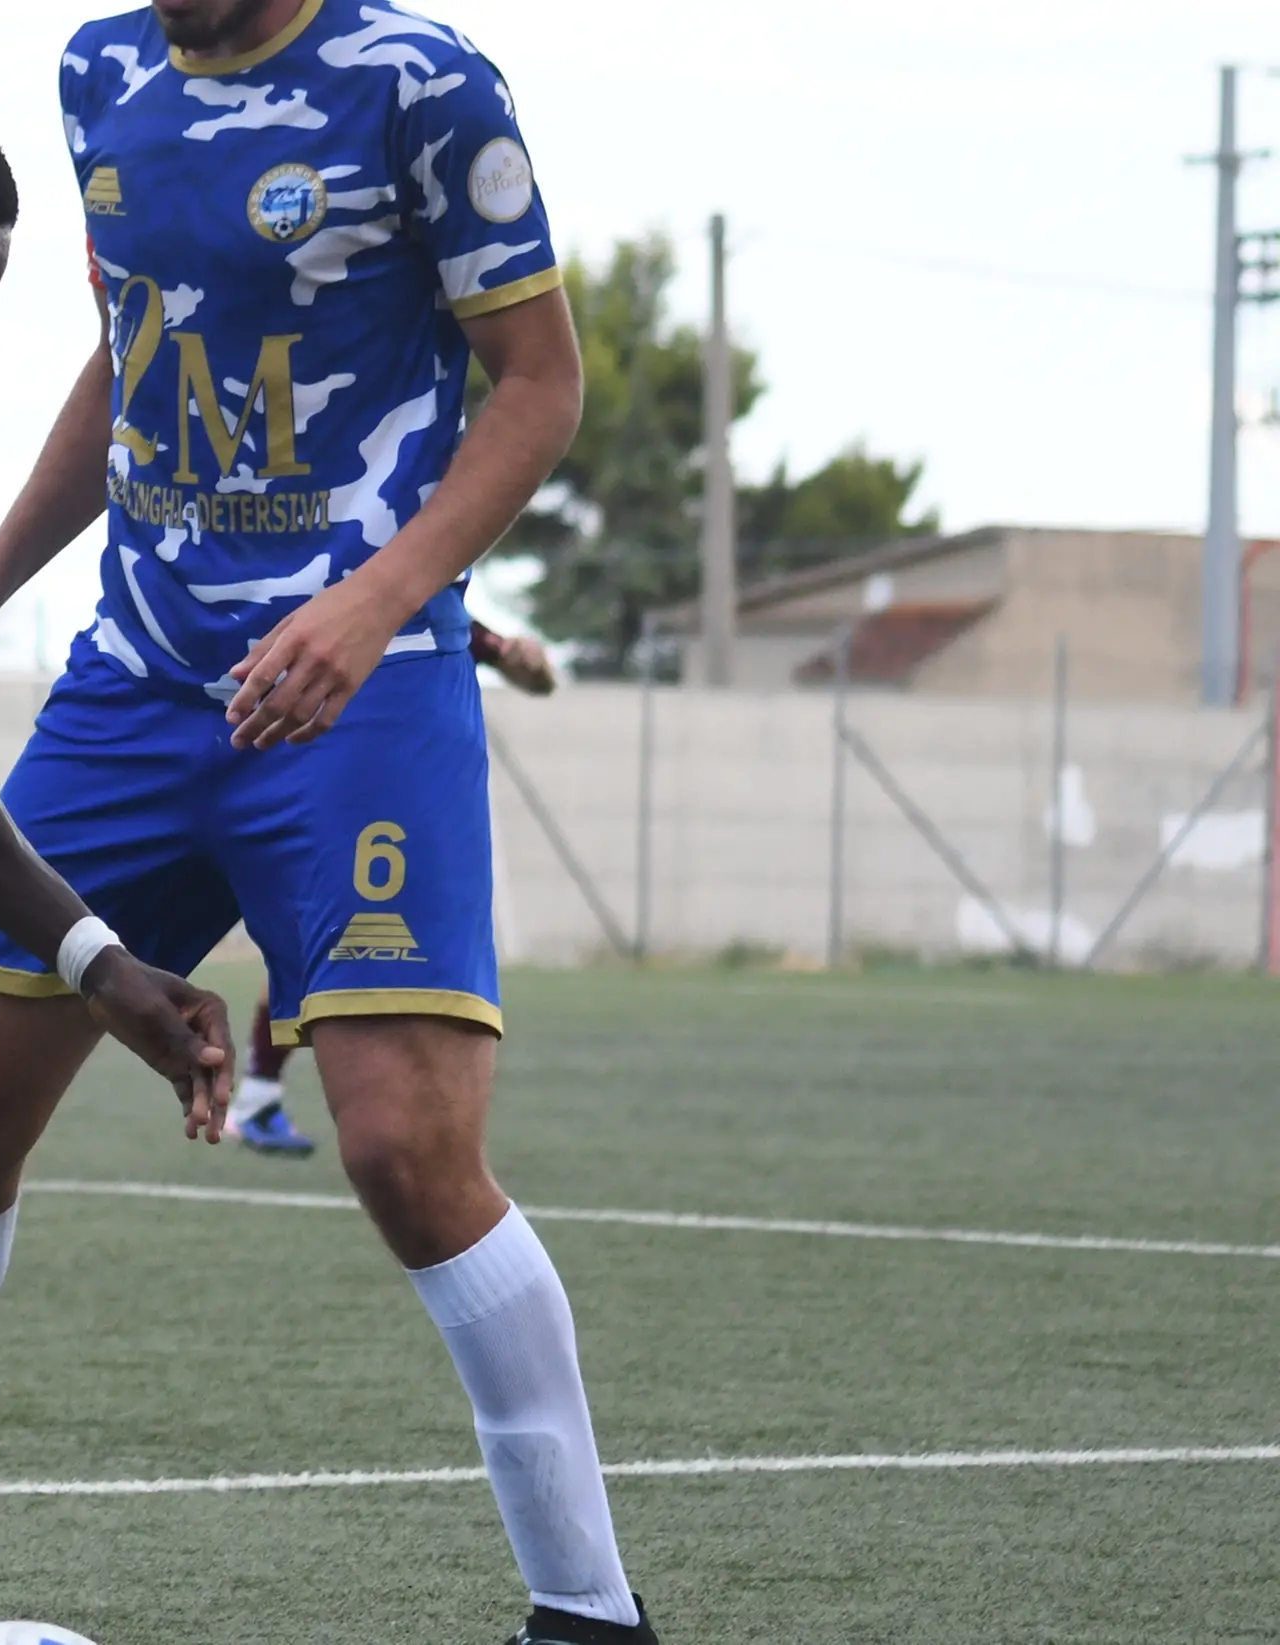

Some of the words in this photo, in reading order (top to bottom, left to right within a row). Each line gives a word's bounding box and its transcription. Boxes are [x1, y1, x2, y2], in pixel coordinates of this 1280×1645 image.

[113, 275, 310, 484] 2M
[353, 821, 407, 902] 6
[328, 948, 429, 962] EVOL
